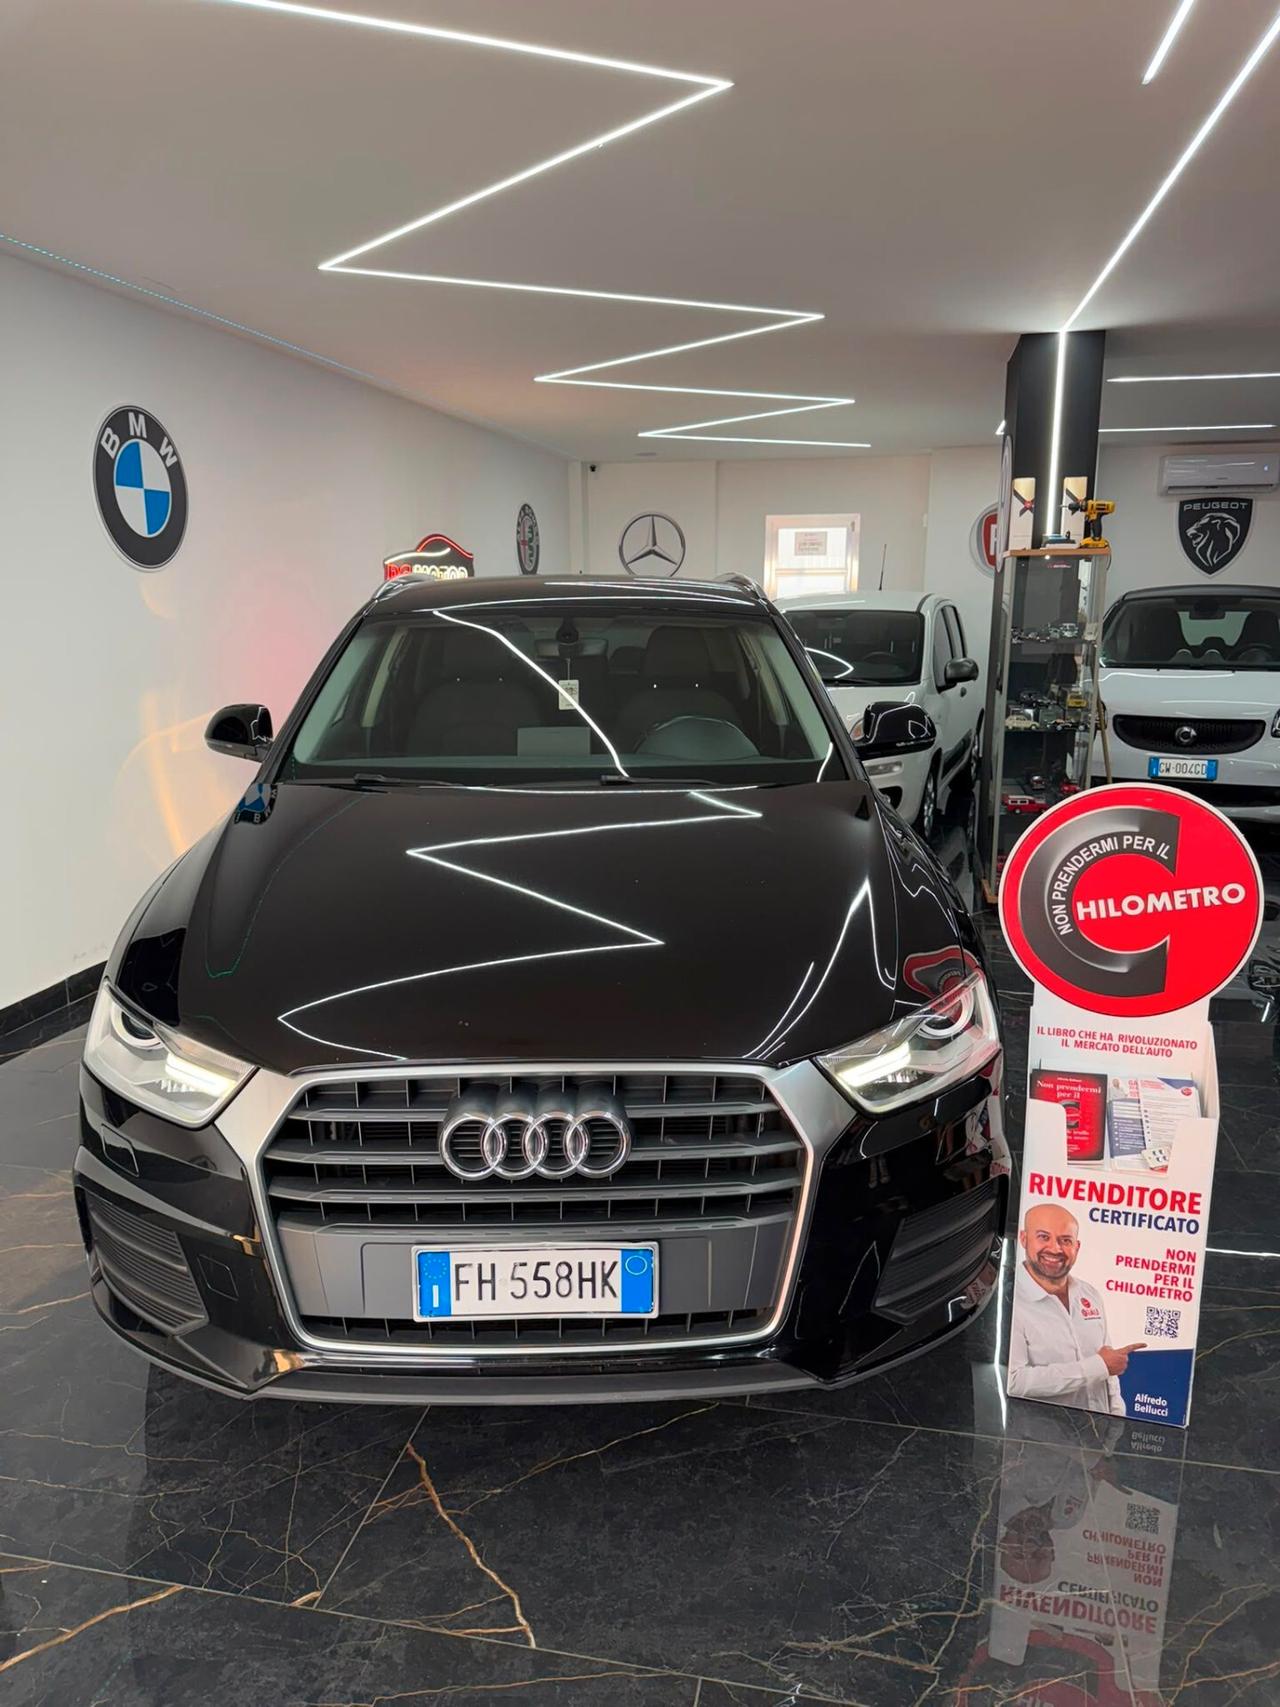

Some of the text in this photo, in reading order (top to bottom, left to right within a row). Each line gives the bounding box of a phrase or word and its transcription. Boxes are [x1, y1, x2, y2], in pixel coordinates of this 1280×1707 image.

[100, 411, 179, 469] BMW
[1183, 501, 1248, 511] PEUGEOT
[1052, 835, 1171, 935] NON PRENDERMI PER IL
[1076, 882, 1246, 921] HILOMETRO
[1037, 1026, 1198, 1050] IL LIBRO CHE HA RIVOLUZIONATO
[1061, 1040, 1173, 1058] IL MERCATO DELL'AUTO
[1037, 1080, 1102, 1094] Non prendermi
[1056, 1090, 1081, 1100] per il
[1029, 1172, 1202, 1215] RIVENDITORE
[1088, 1207, 1200, 1235] CERTIFICATO
[1115, 1255, 1196, 1277] PRENDERMI
[1166, 1248, 1196, 1263] NON
[454, 1262, 497, 1301] FH
[510, 1260, 619, 1300] 558HK
[1106, 1279, 1193, 1302] CHILOMETRO
[1153, 1274, 1195, 1290] PER IL
[1134, 1393, 1168, 1407] Alfredo
[1134, 1404, 1169, 1417] Bellucci
